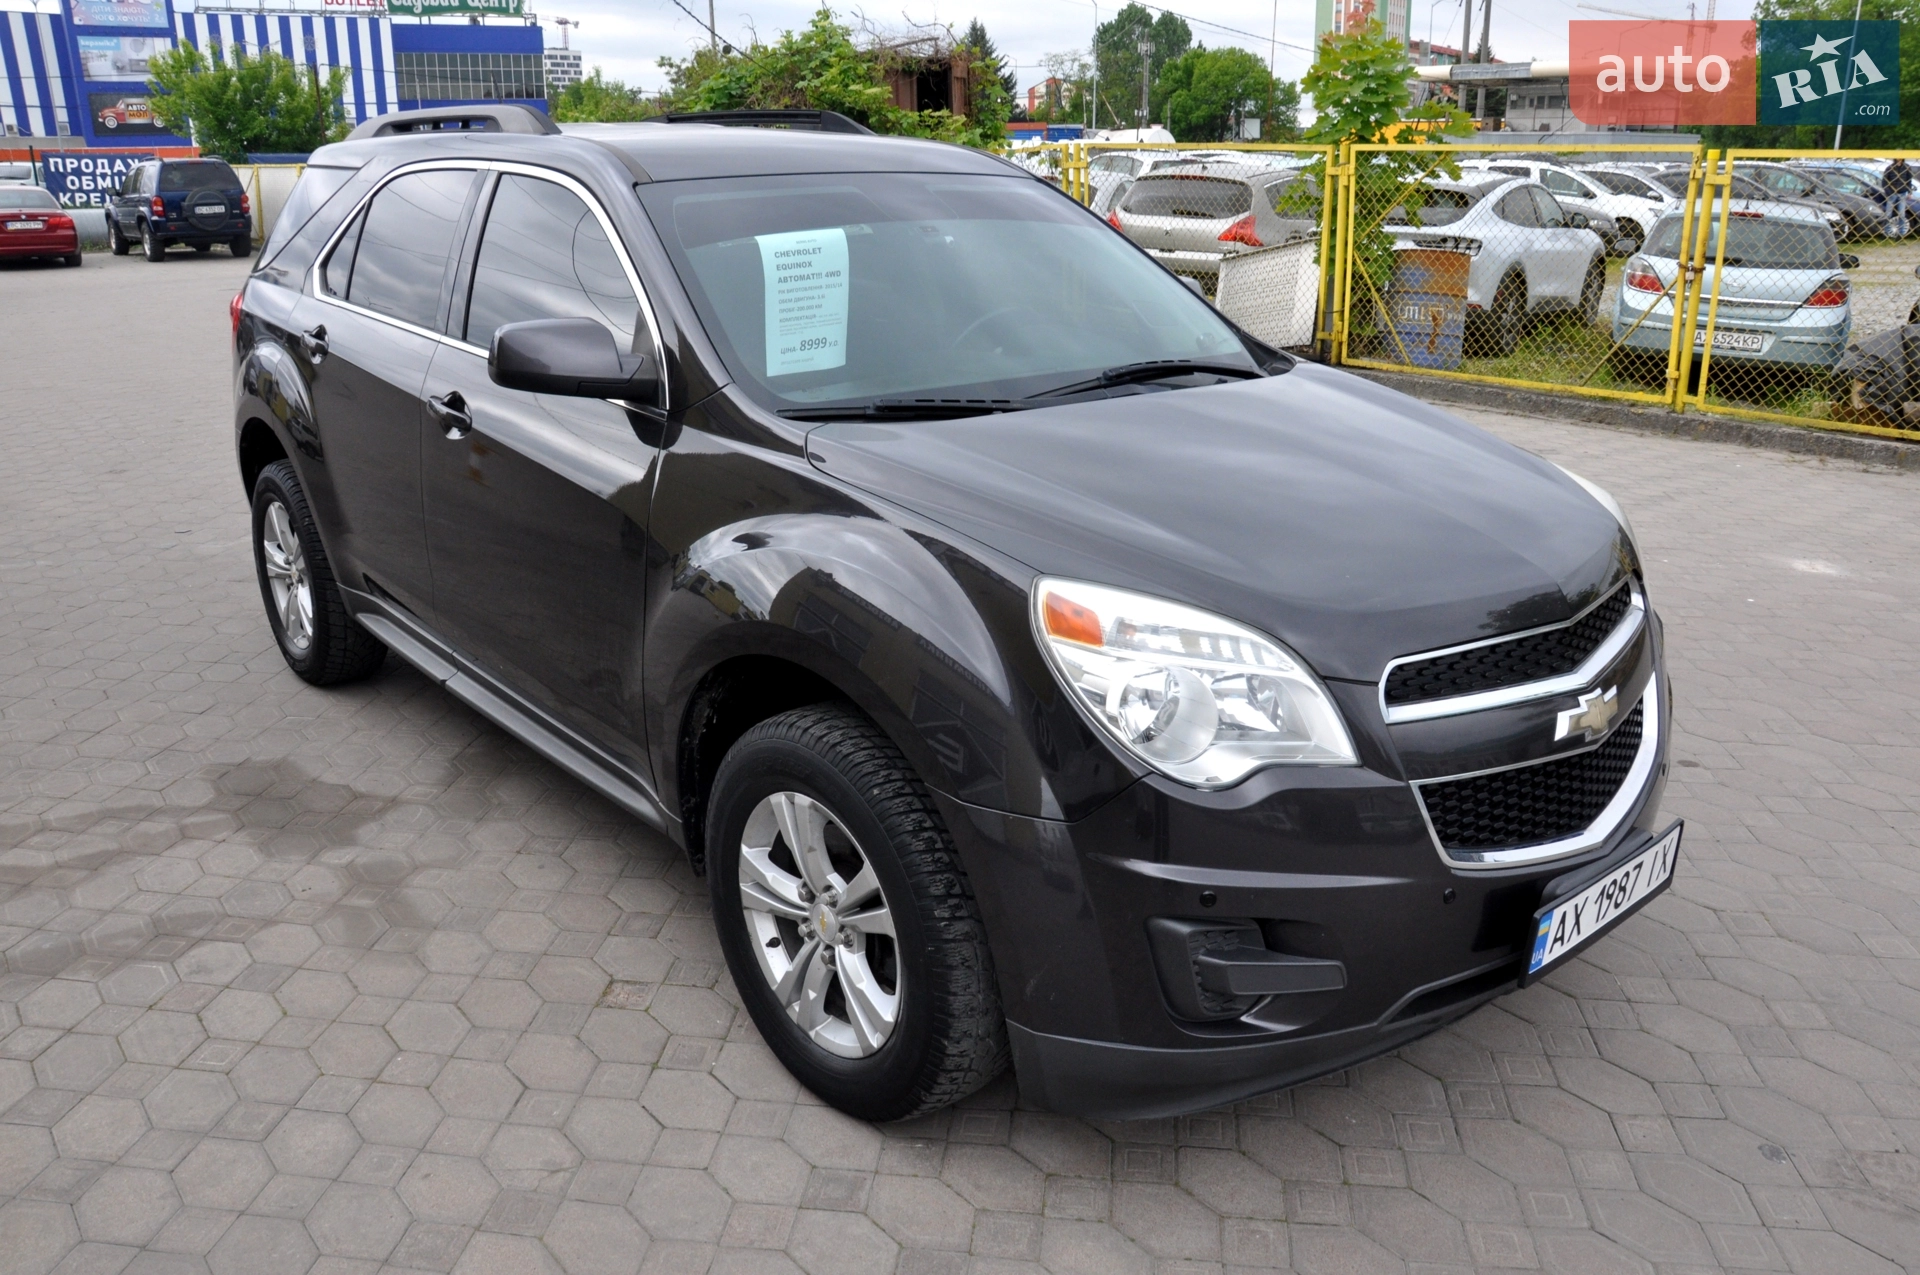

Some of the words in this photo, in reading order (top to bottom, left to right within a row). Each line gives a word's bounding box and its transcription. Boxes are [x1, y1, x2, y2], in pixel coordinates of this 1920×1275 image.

[66, 175, 125, 190] ОБМІ
[774, 247, 822, 258] CHEVROLET
[776, 260, 813, 271] EQUINOX
[777, 272, 823, 284] АВТОМАТ!!!
[824, 270, 842, 278] 4WD
[799, 337, 827, 352] 8999
[1549, 896, 1589, 954] AX
[1594, 860, 1645, 923] 1987
[1647, 837, 1673, 888] IX
[1531, 948, 1543, 965] UA
